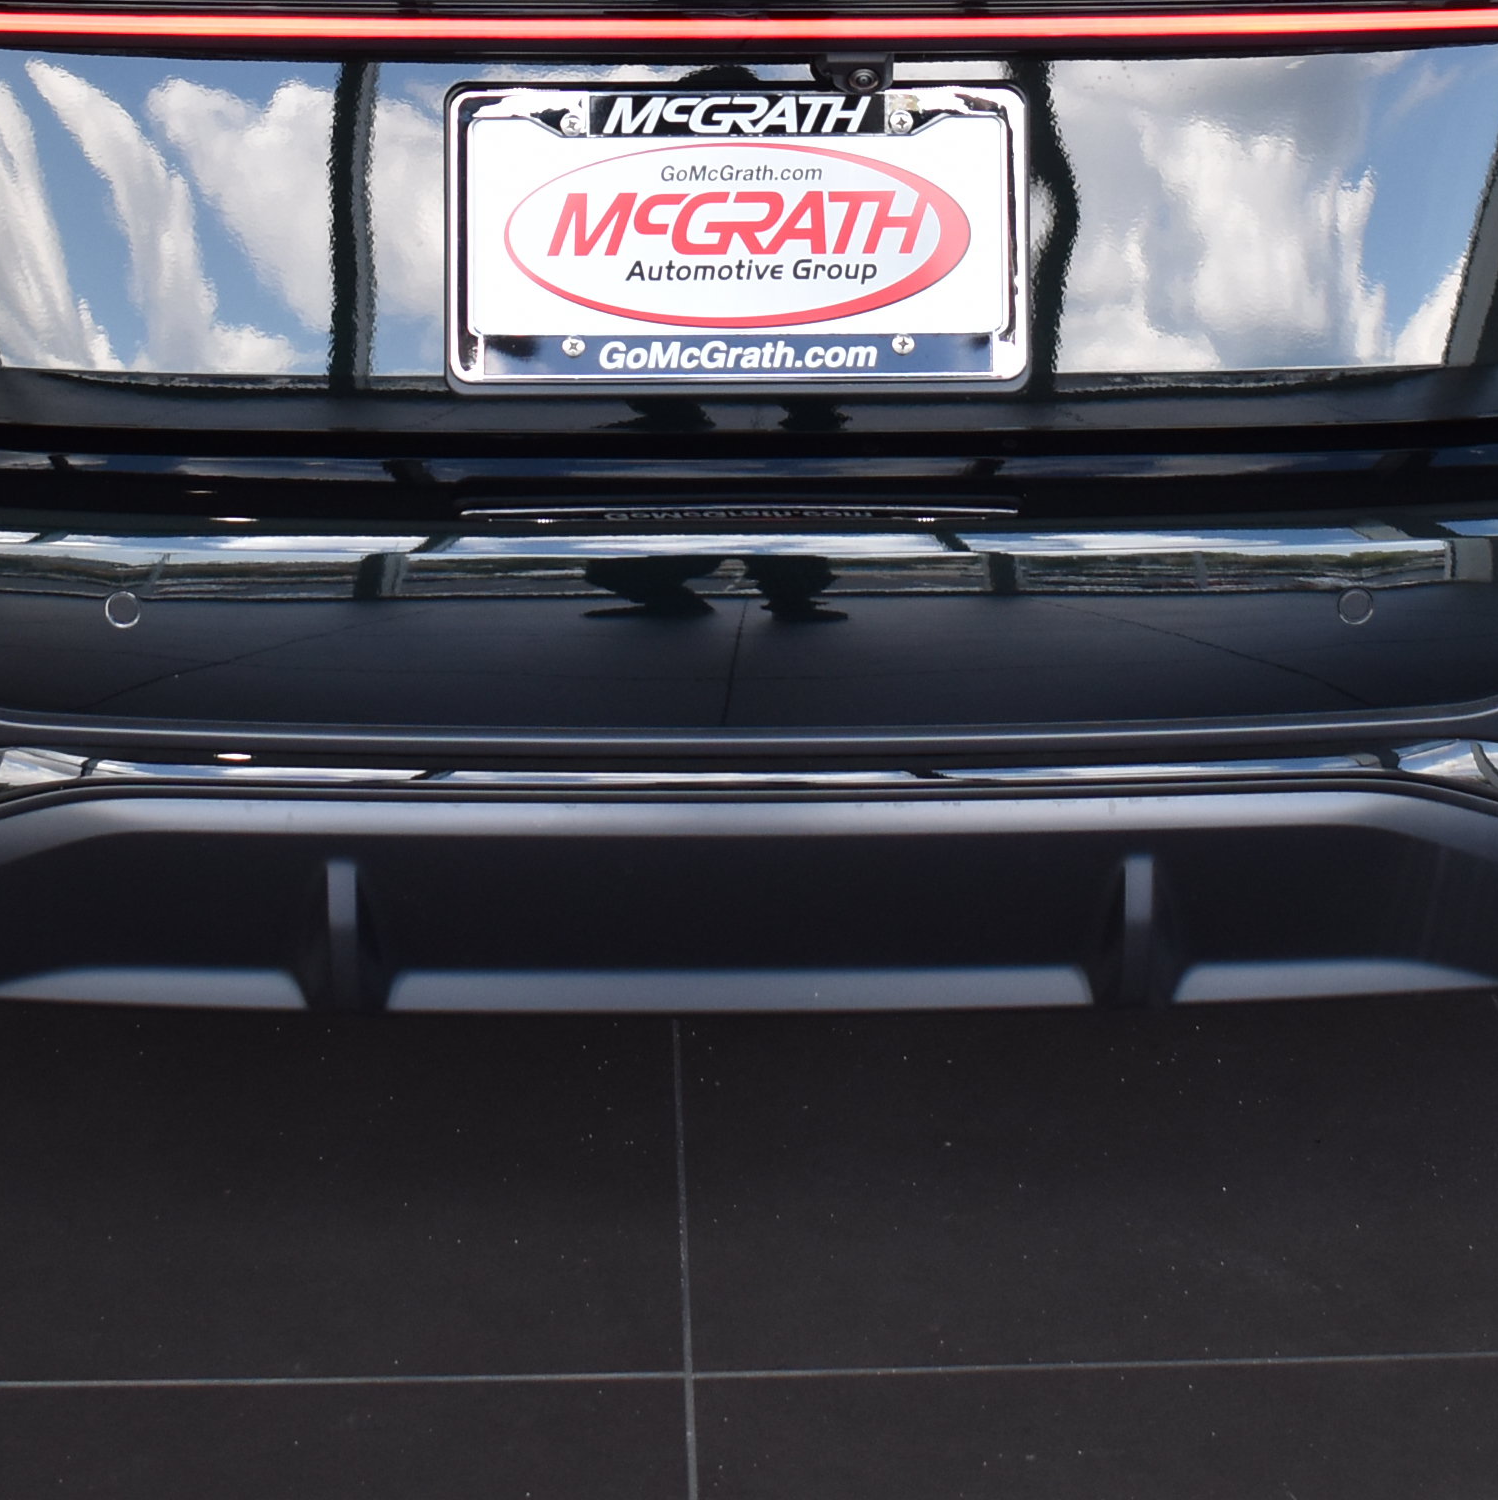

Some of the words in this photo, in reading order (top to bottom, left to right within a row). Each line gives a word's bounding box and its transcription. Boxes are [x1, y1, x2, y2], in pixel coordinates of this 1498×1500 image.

[660, 164, 823, 183] GoMcGrath.com
[625, 258, 784, 282] Automotive
[792, 258, 878, 285] Group
[598, 340, 878, 370] GoMcGrath.com
